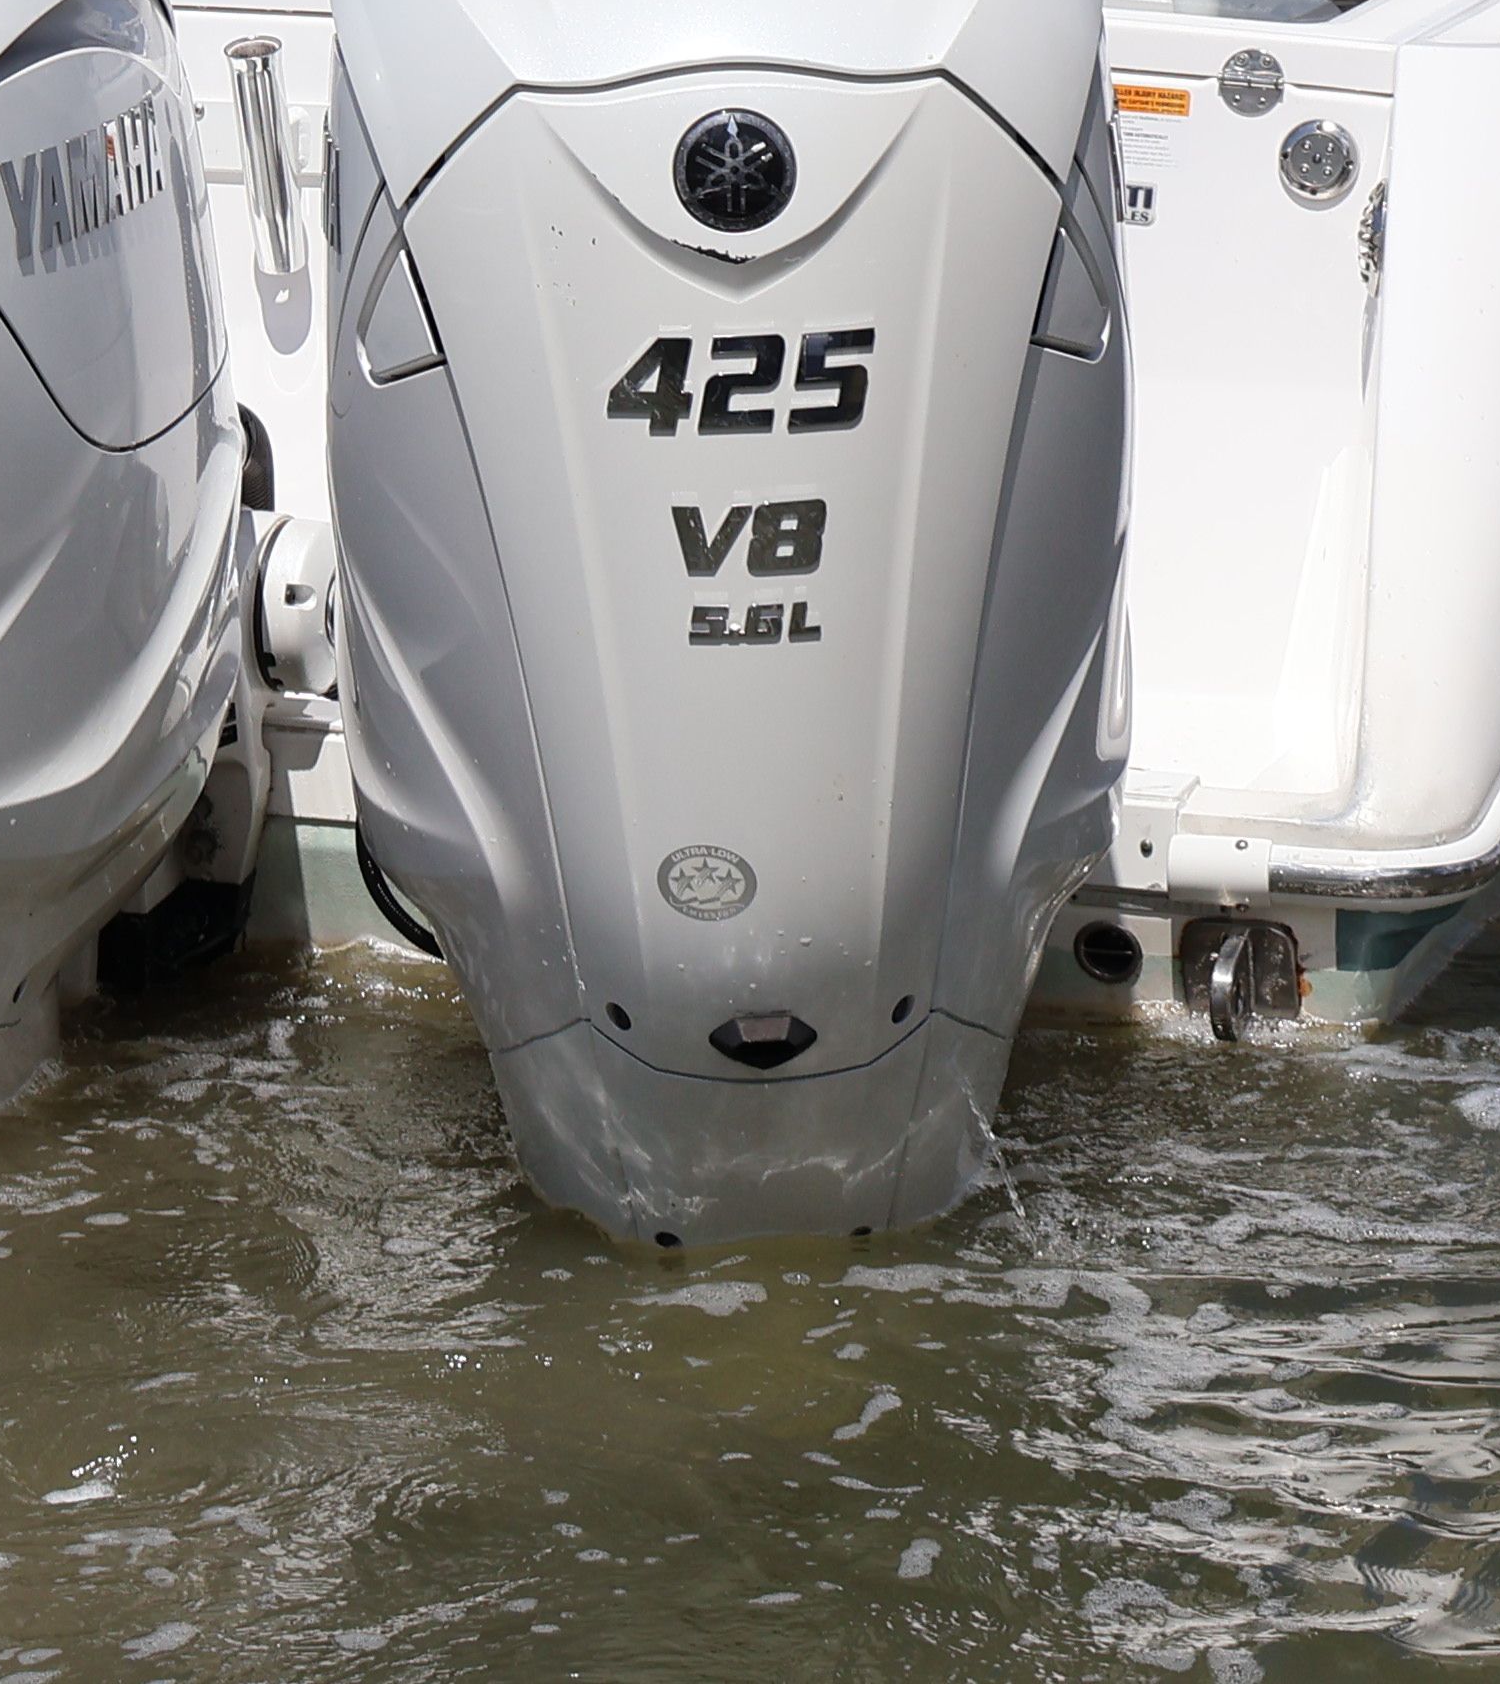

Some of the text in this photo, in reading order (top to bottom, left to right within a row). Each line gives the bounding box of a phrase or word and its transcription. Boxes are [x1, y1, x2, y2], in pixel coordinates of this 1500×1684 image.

[606, 327, 876, 437] 425
[670, 498, 827, 577] V8
[688, 601, 822, 646] 5.6L
[670, 846, 740, 864] ULTRA LOW
